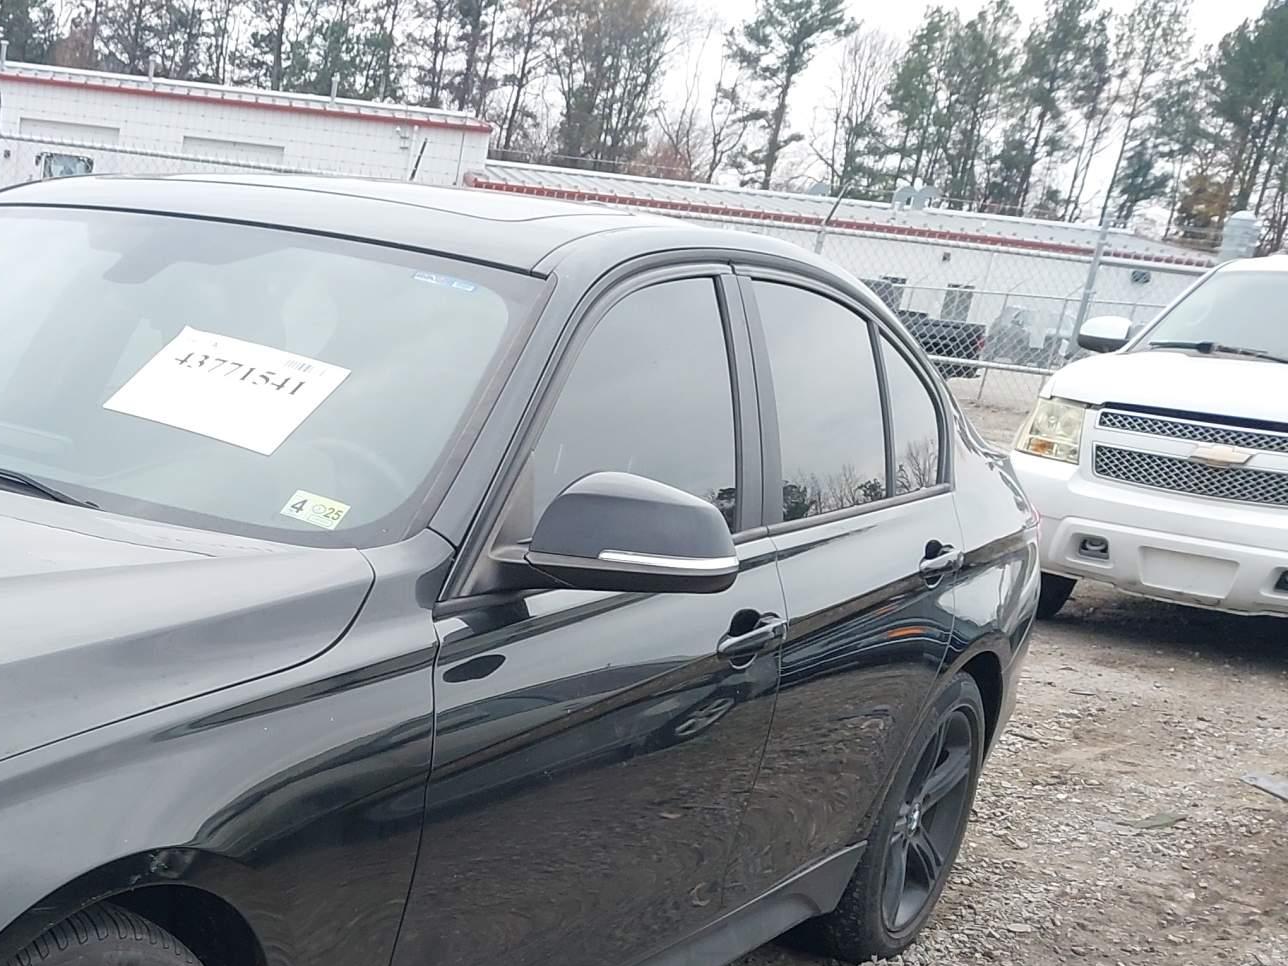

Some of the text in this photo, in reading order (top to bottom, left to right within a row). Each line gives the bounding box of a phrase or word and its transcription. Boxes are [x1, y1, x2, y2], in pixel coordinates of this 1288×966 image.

[175, 352, 306, 395] 43771541
[291, 499, 343, 520] 4 25
